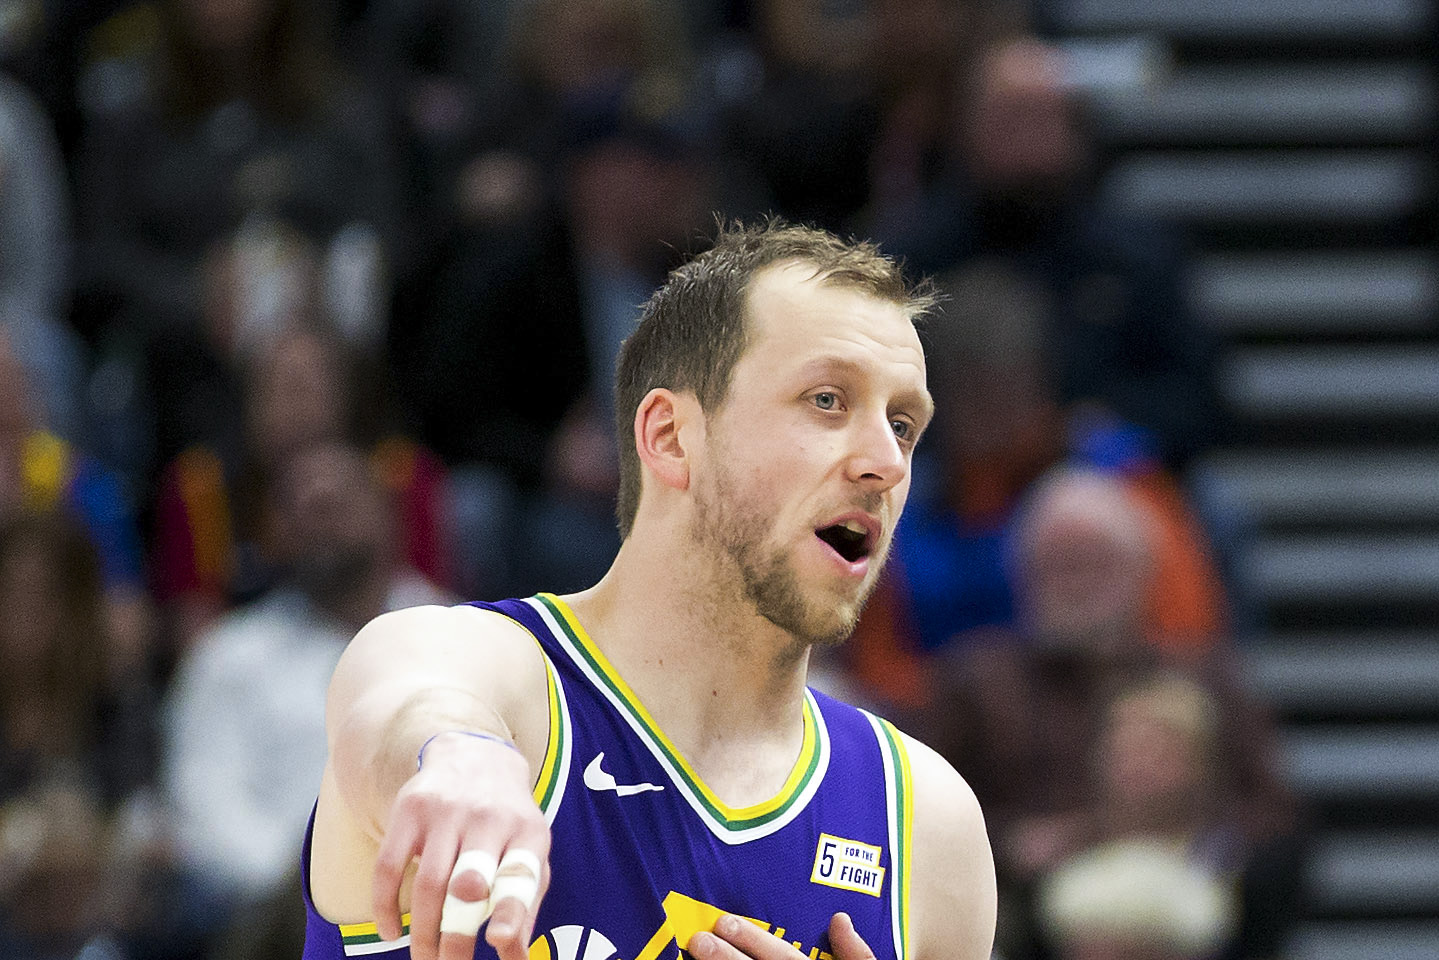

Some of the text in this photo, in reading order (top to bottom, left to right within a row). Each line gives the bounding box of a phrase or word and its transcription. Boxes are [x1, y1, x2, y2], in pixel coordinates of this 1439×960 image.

[820, 842, 837, 878] 5
[845, 847, 874, 862] FOR THE
[840, 865, 878, 888] FIGHT
